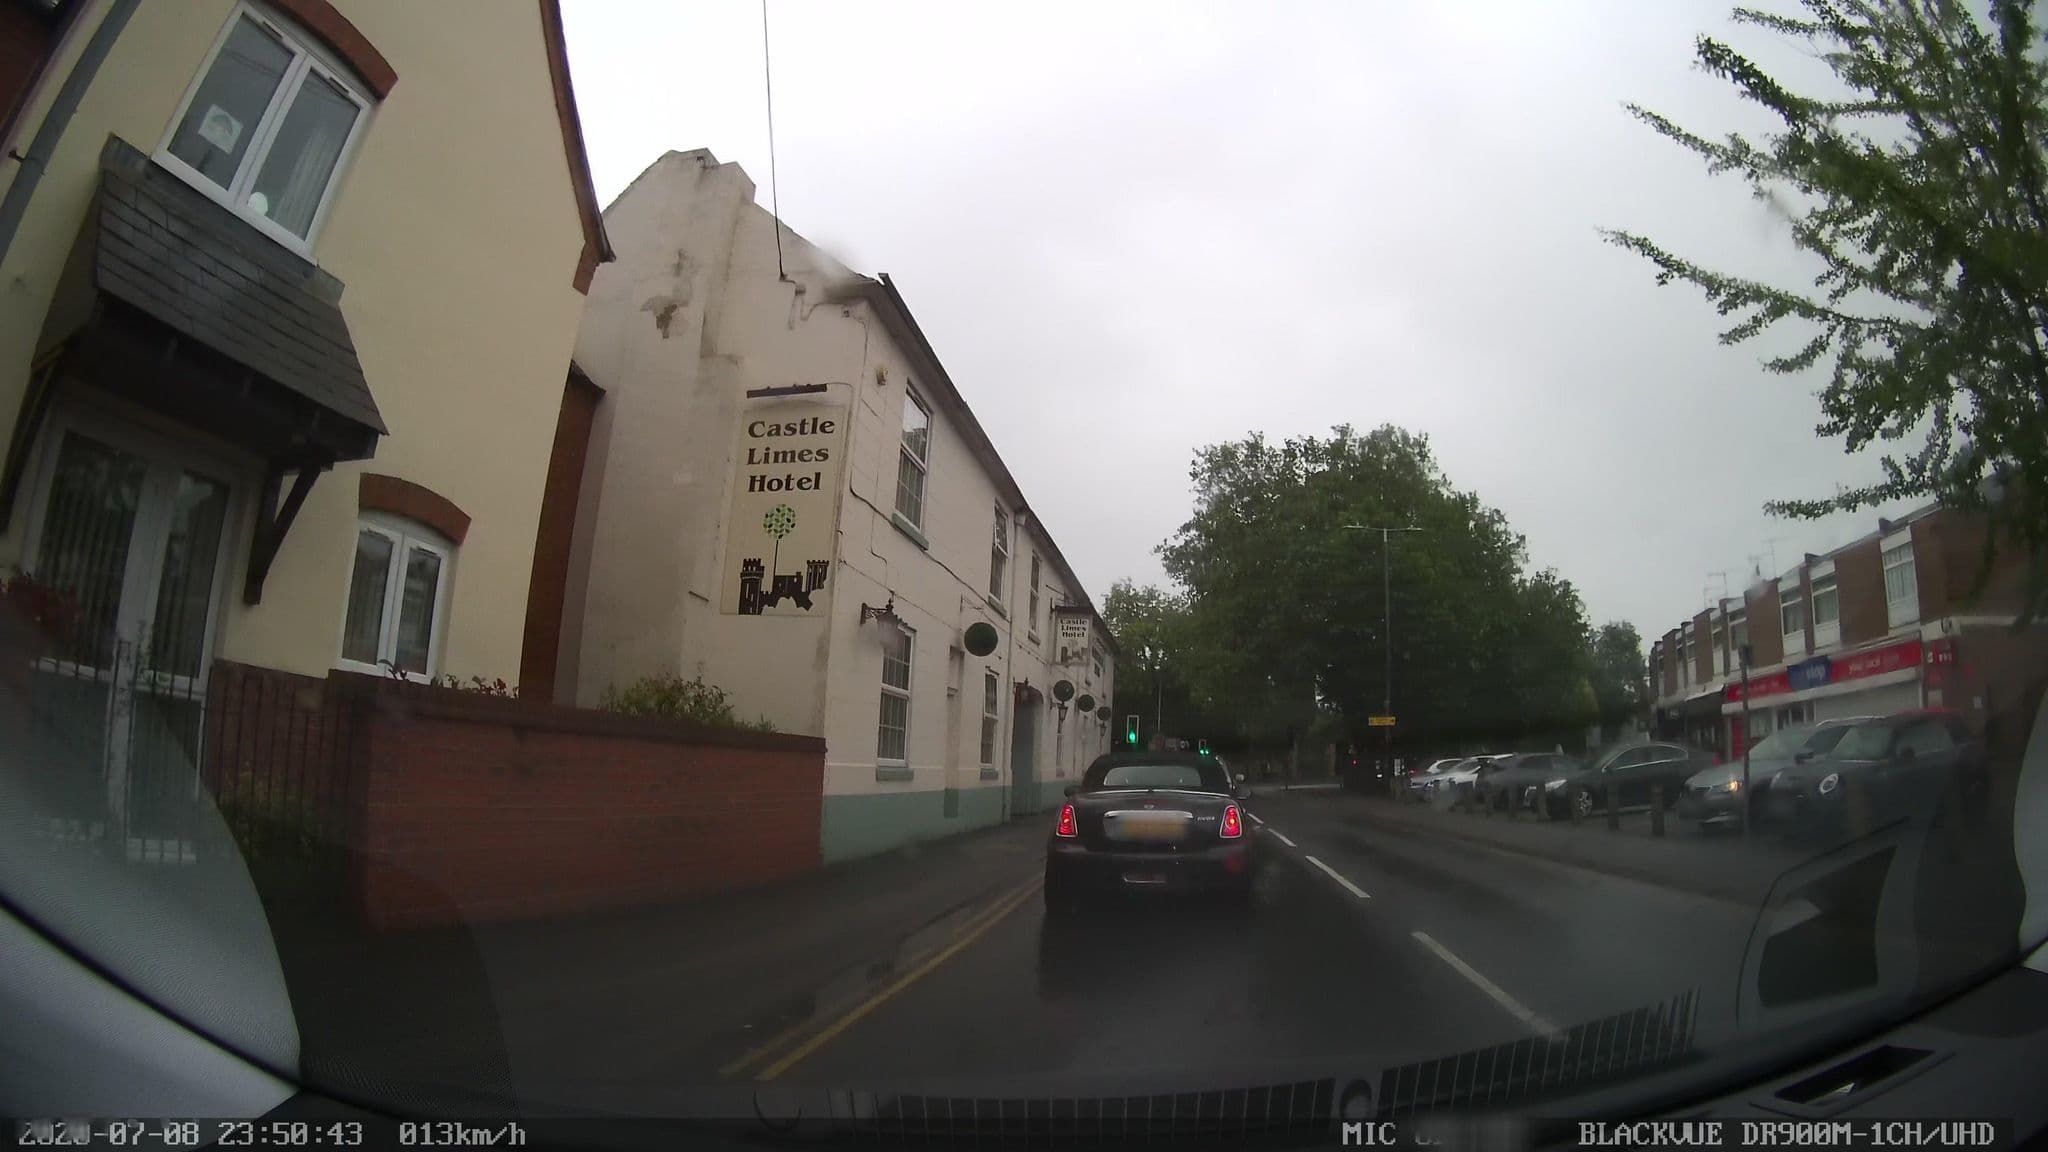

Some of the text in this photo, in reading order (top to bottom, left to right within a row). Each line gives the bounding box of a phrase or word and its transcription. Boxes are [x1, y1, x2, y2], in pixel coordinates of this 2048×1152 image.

[748, 416, 836, 439] Castle
[746, 447, 830, 466] Limes
[747, 471, 822, 493] Hotel
